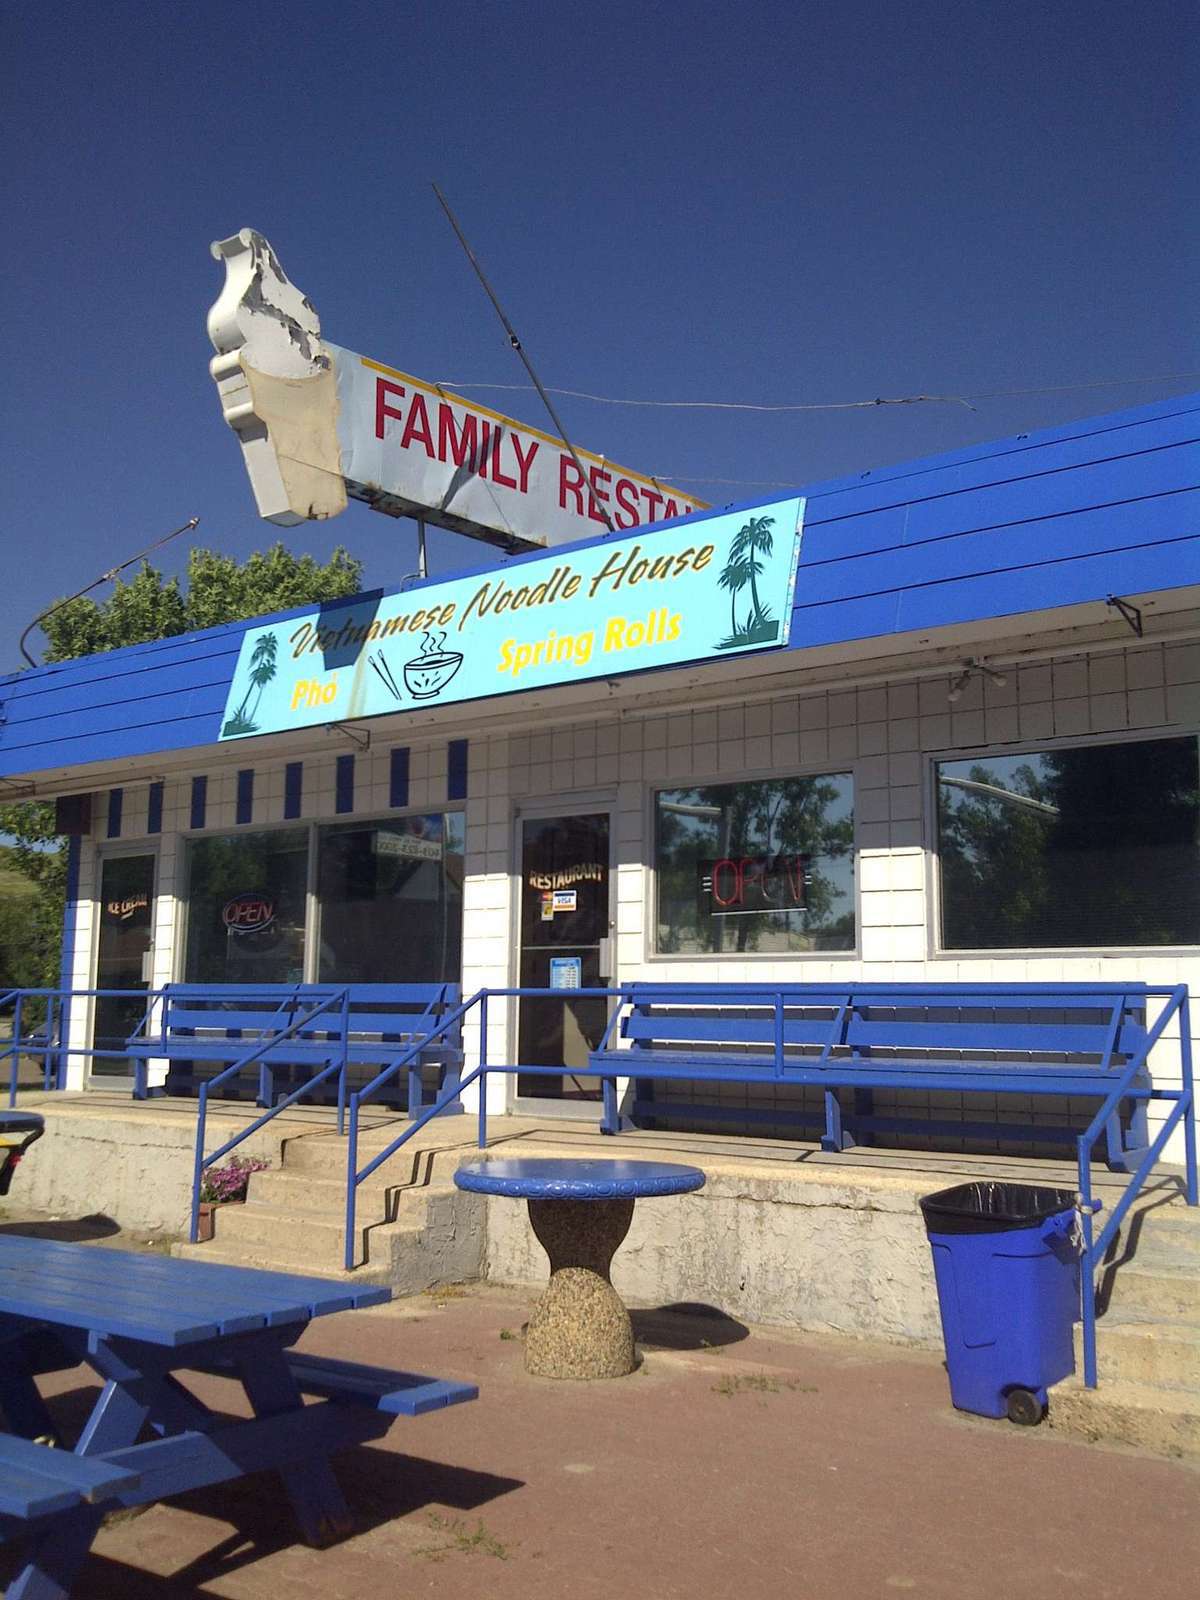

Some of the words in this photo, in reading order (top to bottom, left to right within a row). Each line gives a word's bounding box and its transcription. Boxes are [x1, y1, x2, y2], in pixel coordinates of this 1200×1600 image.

[375, 377, 539, 493] FAMILY
[559, 454, 693, 530] REST
[290, 602, 456, 659] Vietnamese
[459, 566, 581, 630] Noodle
[589, 545, 714, 598] House
[498, 629, 594, 677] Spring
[604, 608, 682, 652] Rolls
[529, 863, 604, 889] RESTAURANT
[712, 856, 802, 905] OPEN
[225, 901, 273, 923] OPEN
